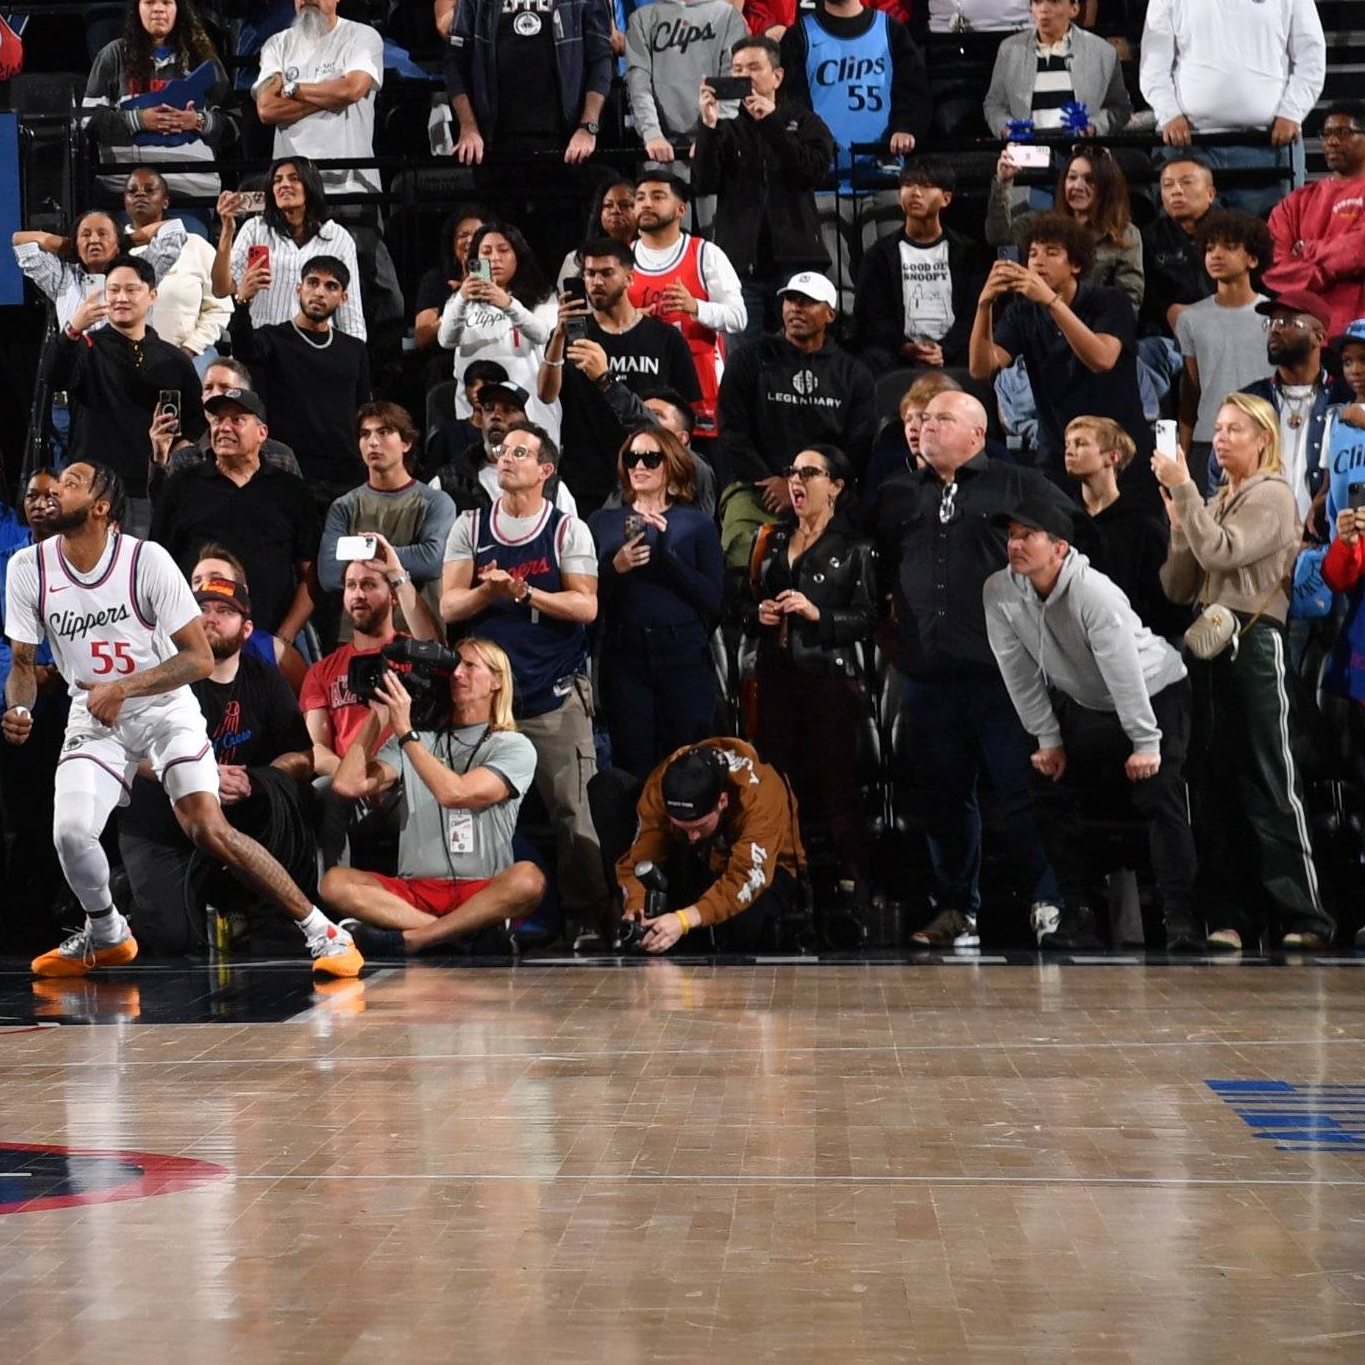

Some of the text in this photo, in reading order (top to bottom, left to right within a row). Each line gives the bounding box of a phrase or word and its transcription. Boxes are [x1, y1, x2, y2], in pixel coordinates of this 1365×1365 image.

[652, 18, 718, 55] Clips
[817, 53, 886, 91] Clips
[846, 84, 883, 113] 55
[902, 270, 949, 283] SNOOPY
[607, 353, 661, 378] MAIN
[47, 603, 131, 644] Clippers
[90, 640, 138, 677] 55
